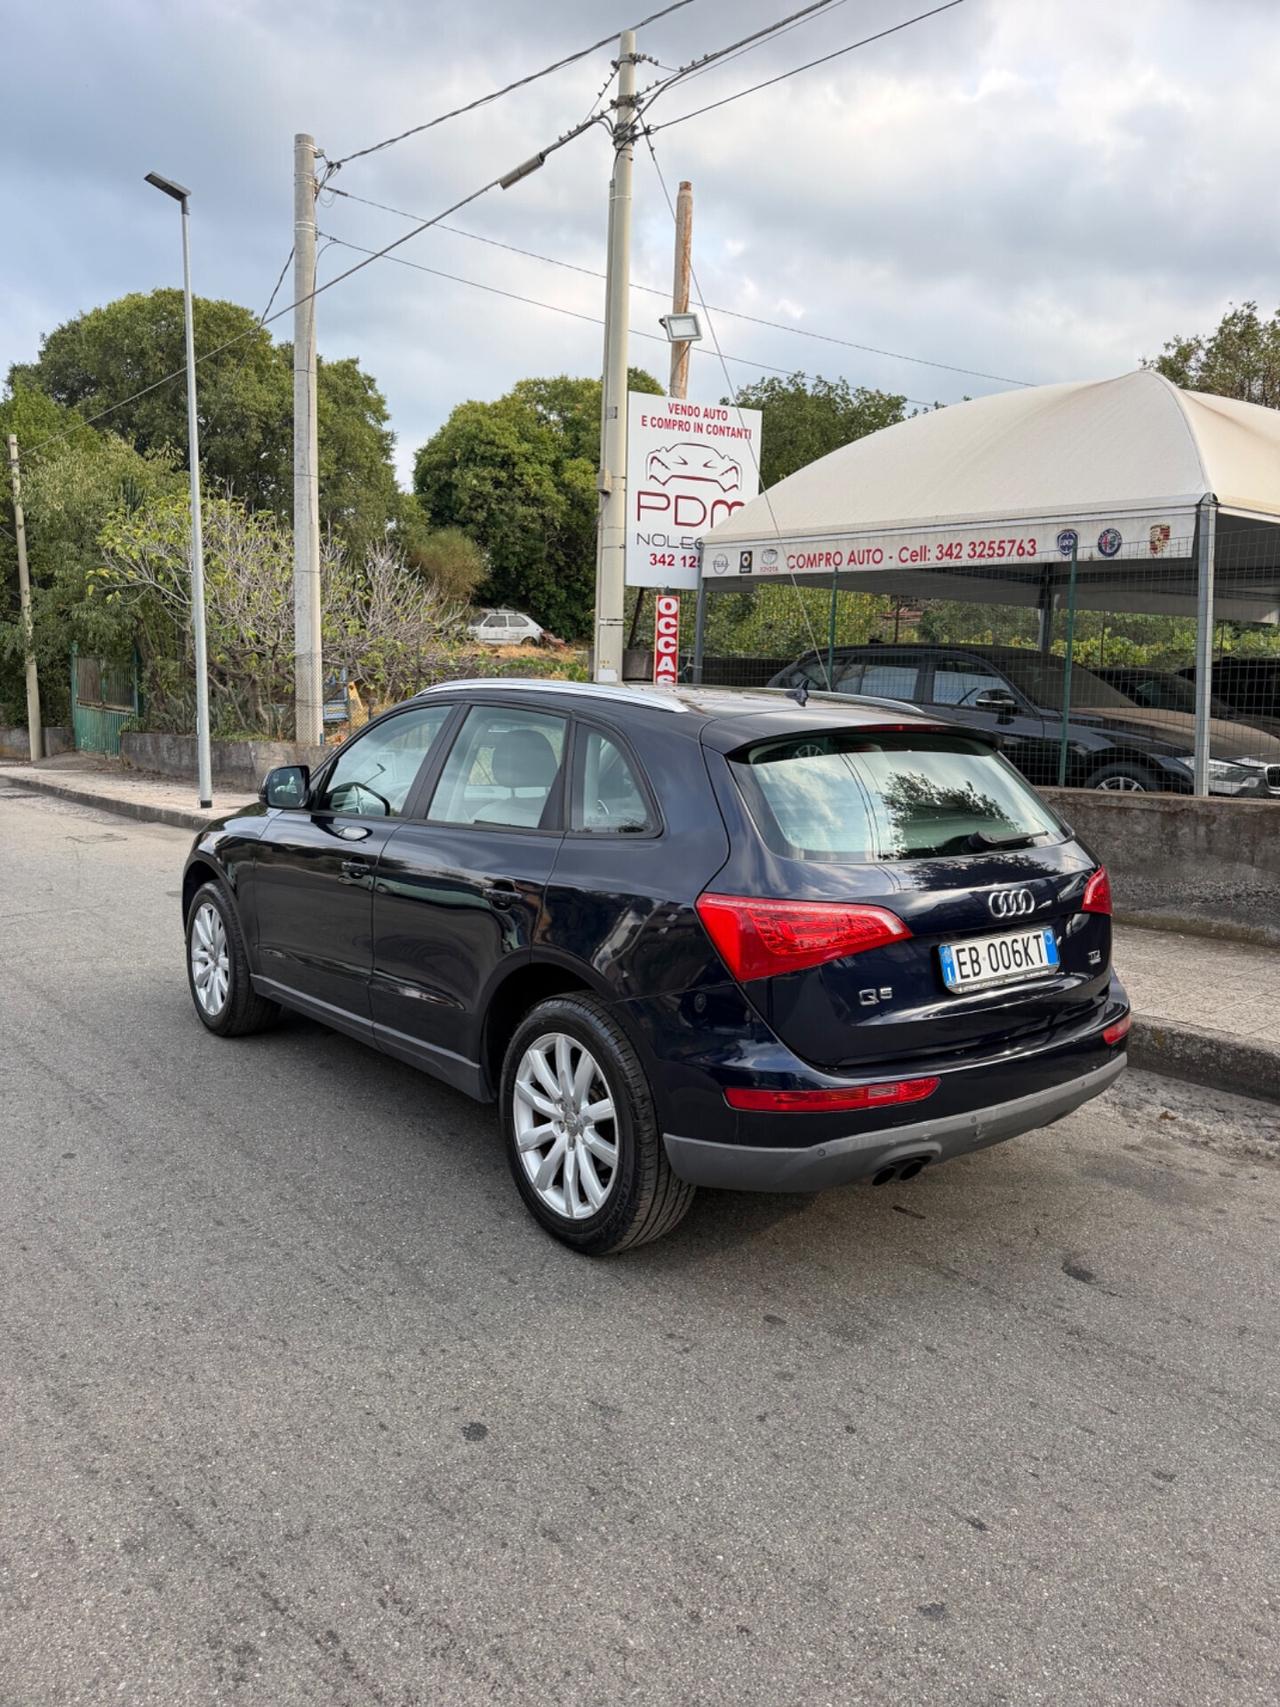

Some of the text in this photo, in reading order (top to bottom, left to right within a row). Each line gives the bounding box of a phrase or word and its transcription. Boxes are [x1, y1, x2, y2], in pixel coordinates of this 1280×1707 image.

[668, 402, 728, 421] VENDO AUTO
[641, 415, 752, 440] E COMPRO IN CONTANTI
[649, 553, 675, 567] 342
[786, 550, 843, 570] COMPRO
[847, 548, 883, 566] AUTO
[898, 545, 931, 563] Cell:
[935, 542, 963, 561] 342
[967, 538, 1037, 559] 3255763
[955, 934, 1044, 980] EB 006KT
[859, 987, 892, 1005] Q5
